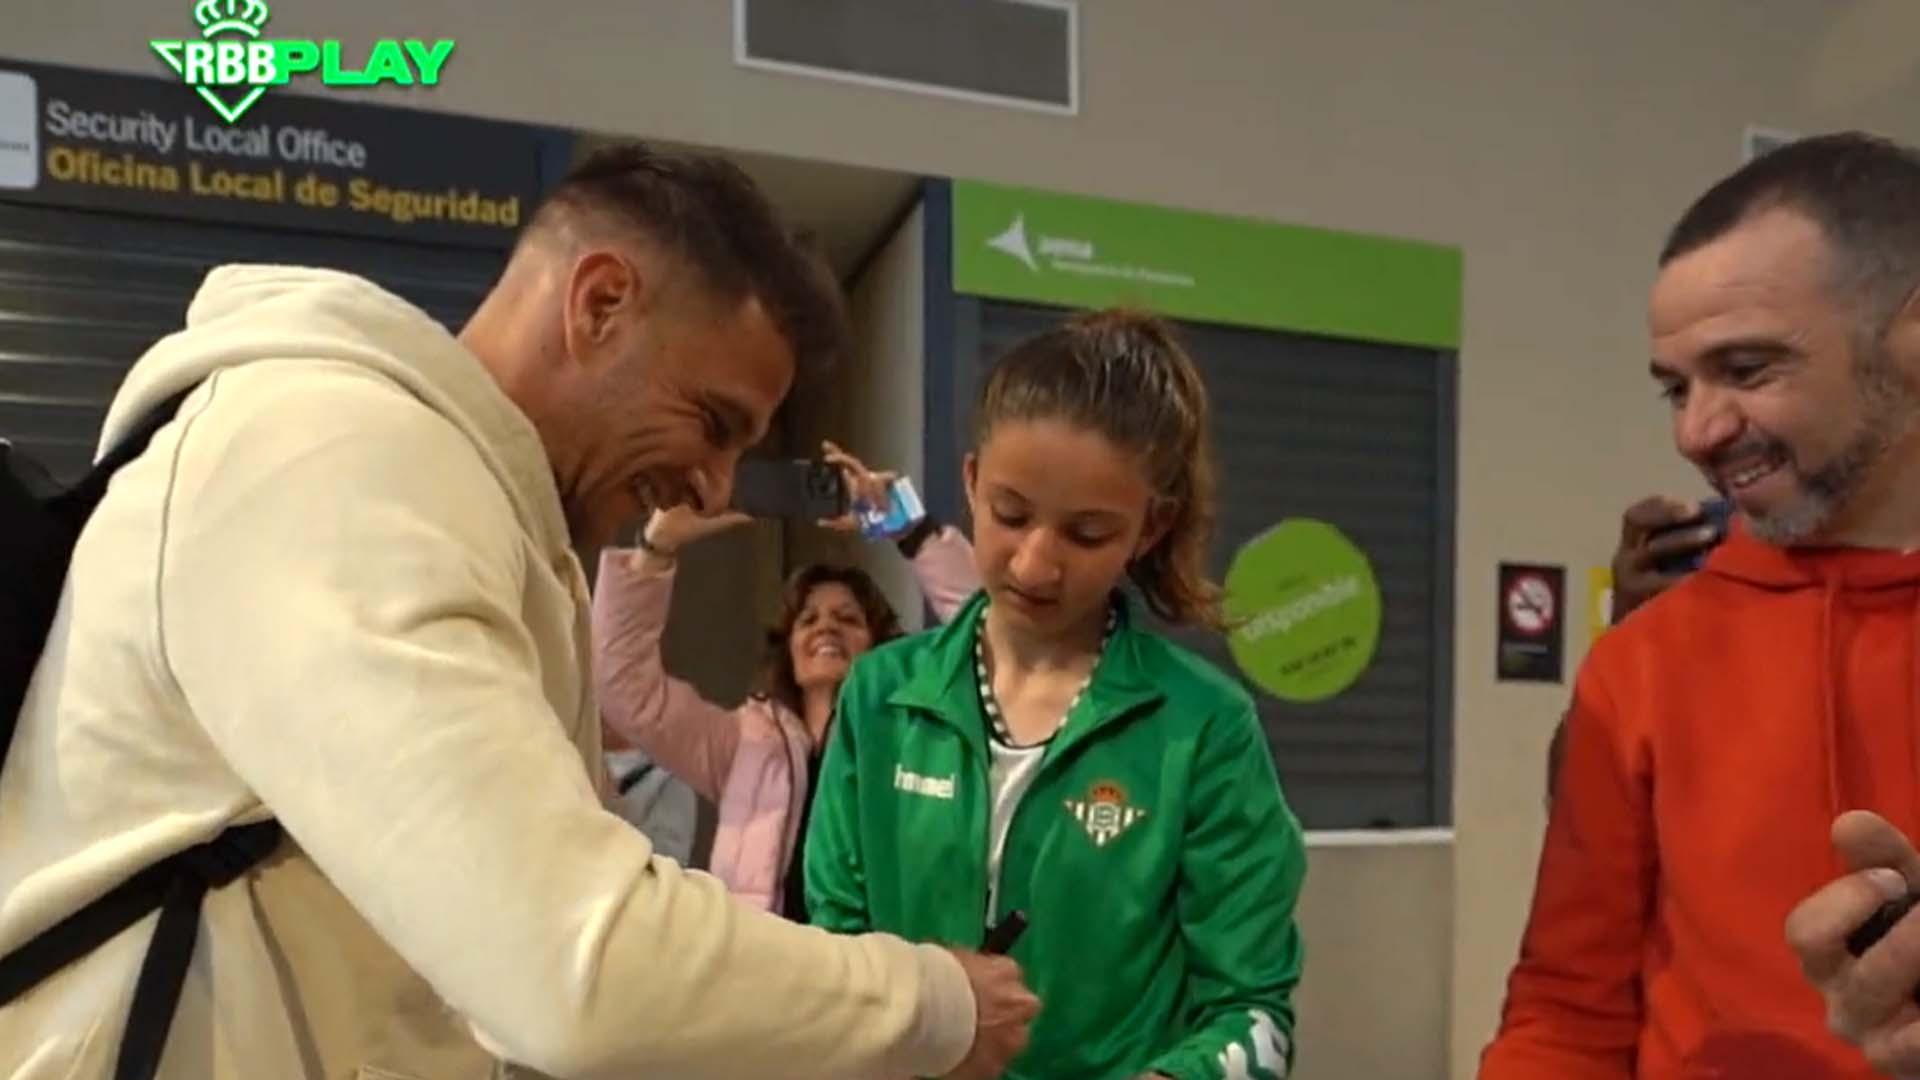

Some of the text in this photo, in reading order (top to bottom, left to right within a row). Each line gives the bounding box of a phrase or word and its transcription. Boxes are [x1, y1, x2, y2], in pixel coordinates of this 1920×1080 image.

[46, 100, 367, 168] Security Local Office
[47, 148, 520, 227] Oficina Local de Seguridad
